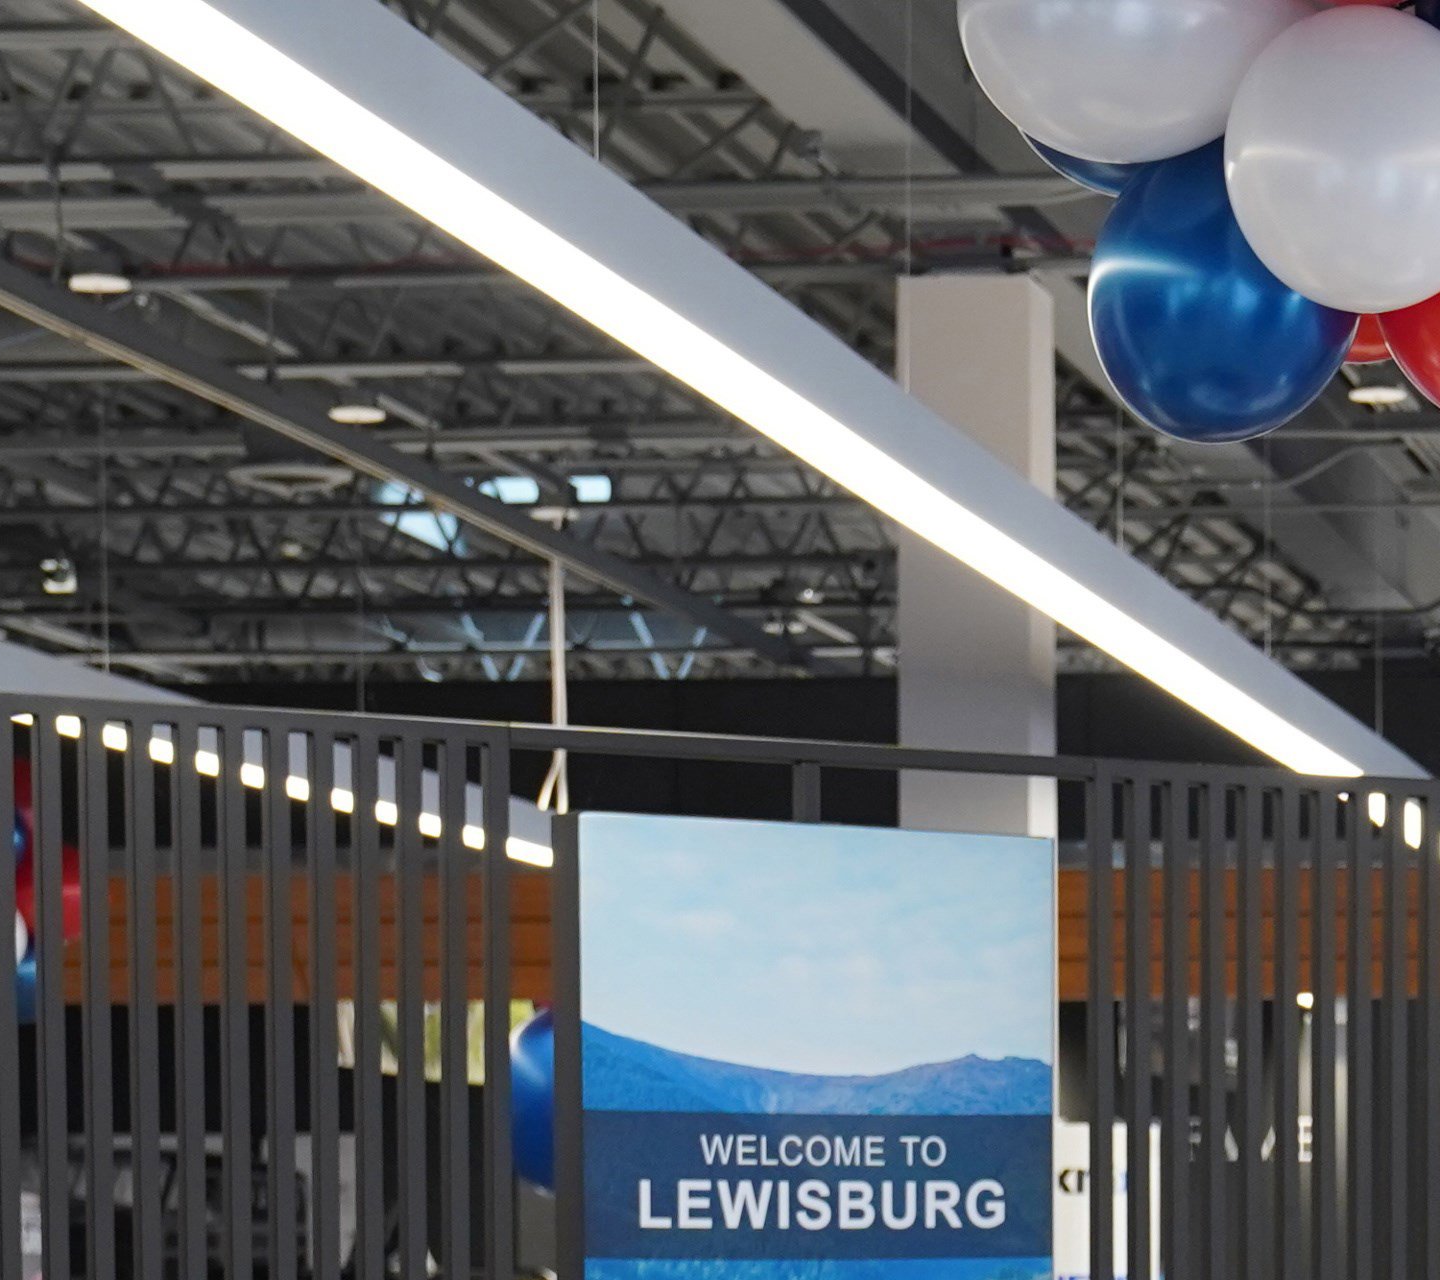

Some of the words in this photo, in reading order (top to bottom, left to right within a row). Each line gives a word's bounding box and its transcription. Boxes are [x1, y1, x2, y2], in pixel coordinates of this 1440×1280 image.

[699, 1134, 886, 1167] WELCOME
[899, 1135, 947, 1167] TO
[637, 1178, 1007, 1231] LEWISBURG
